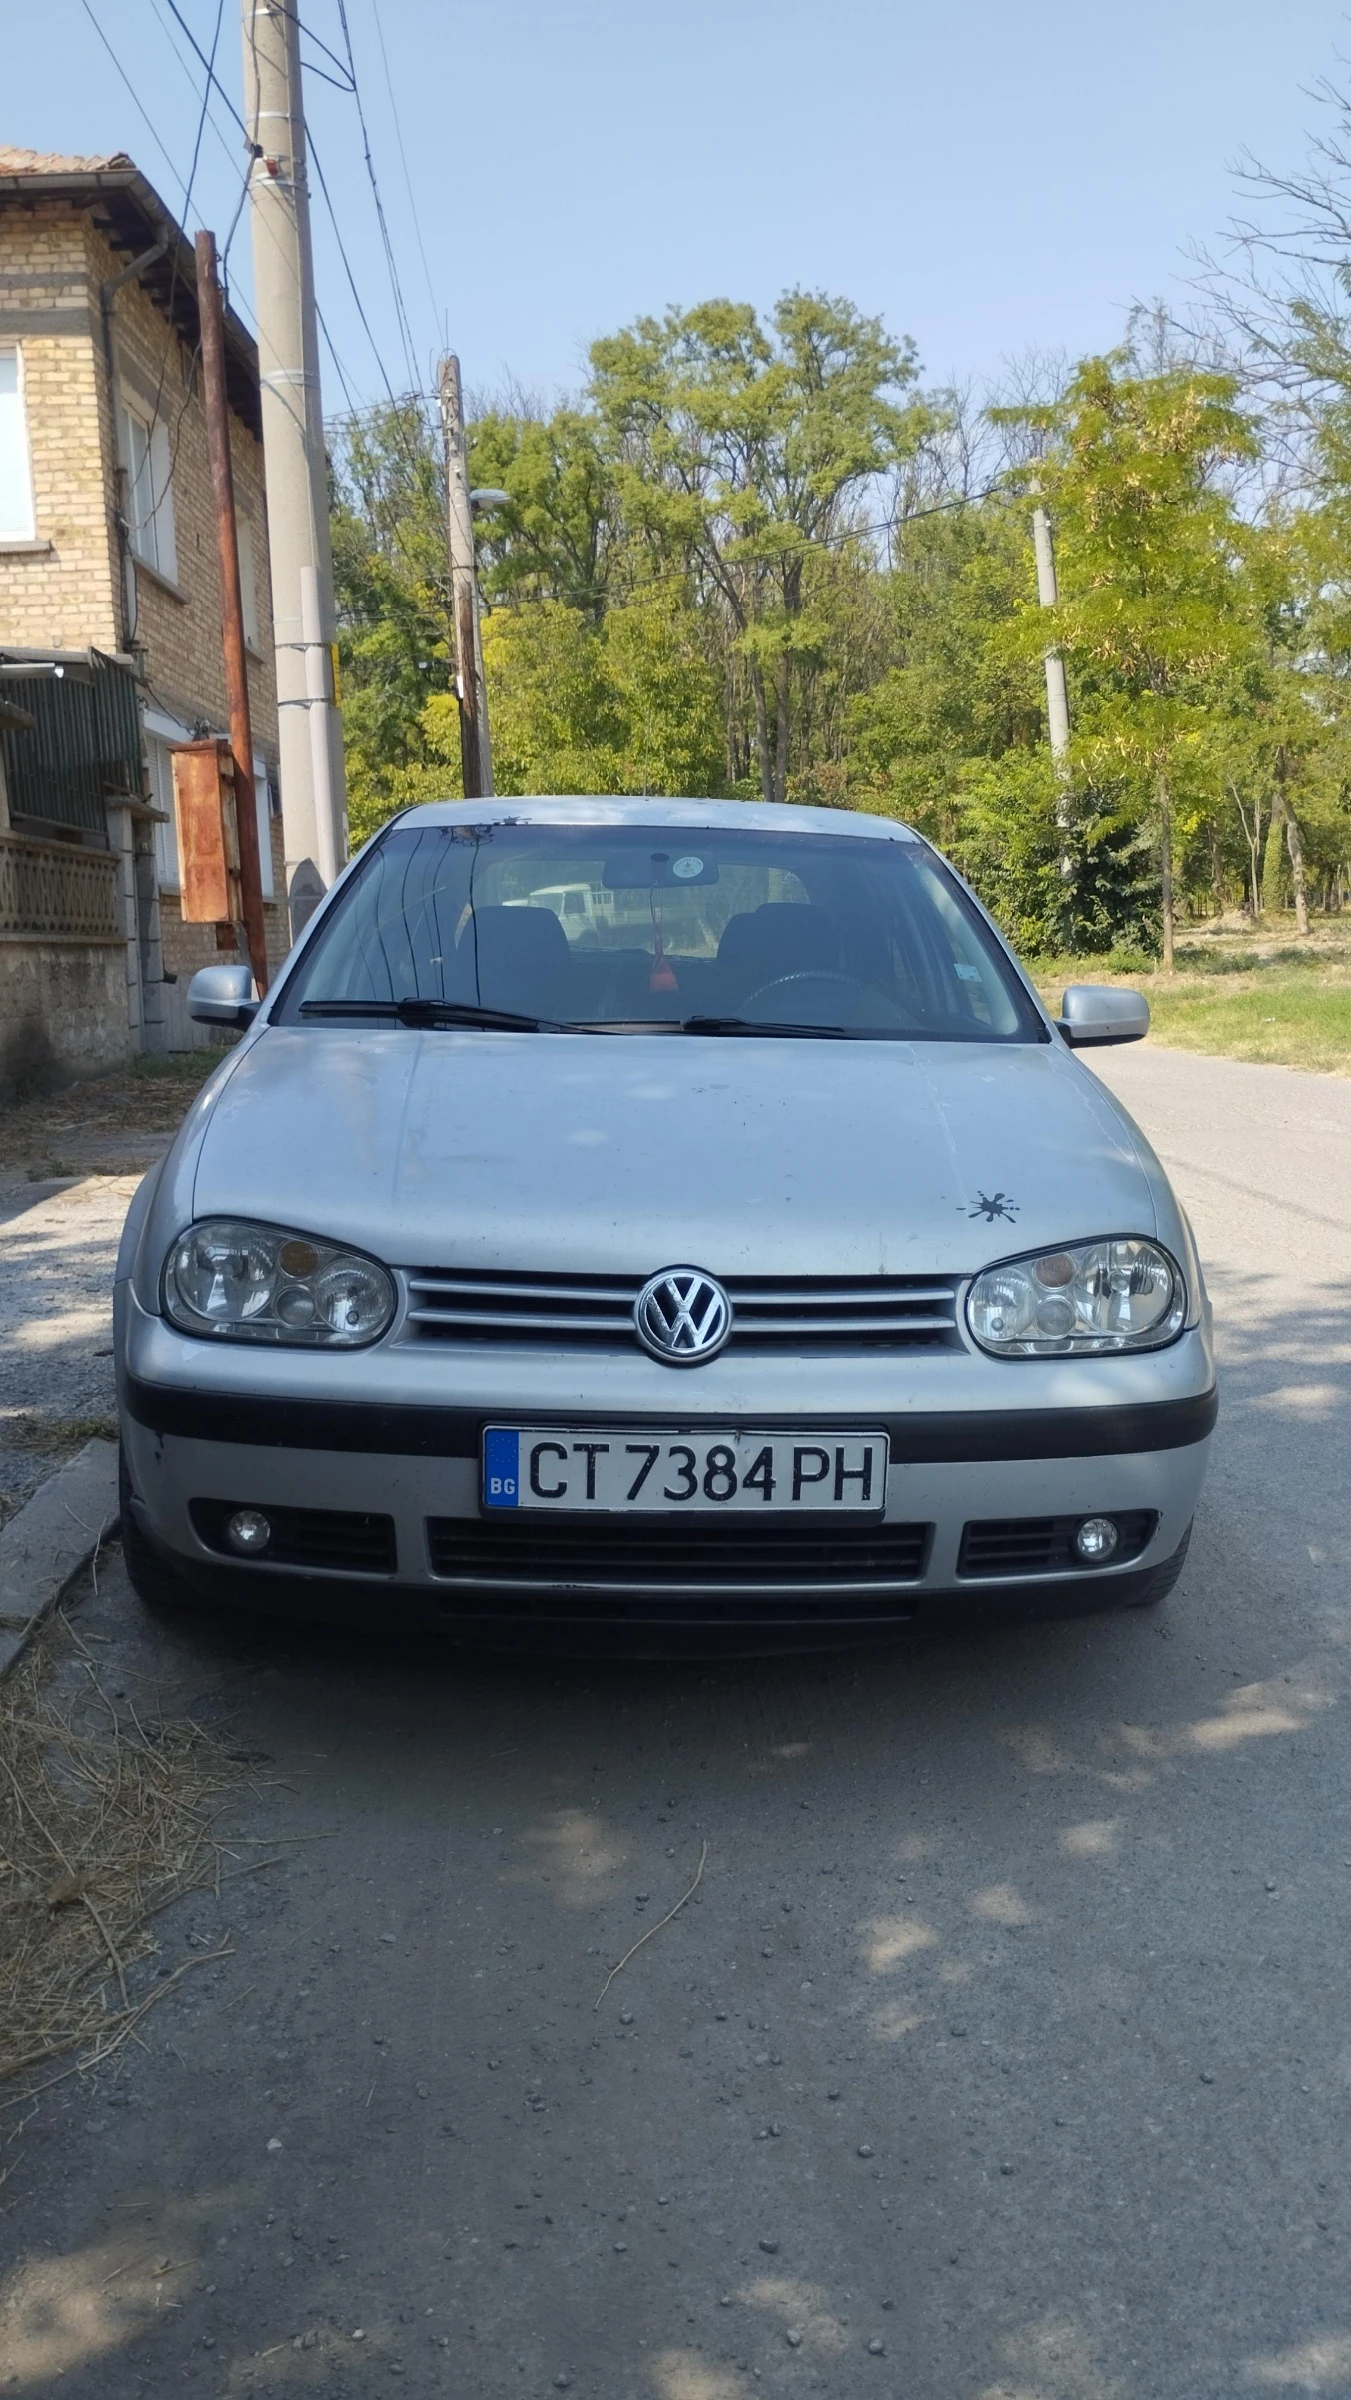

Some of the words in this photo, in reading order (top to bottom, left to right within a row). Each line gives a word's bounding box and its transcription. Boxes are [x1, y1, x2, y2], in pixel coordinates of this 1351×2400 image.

[641, 1272, 725, 1354] VW
[490, 1477, 516, 1495] BG
[529, 1441, 610, 1499] CT
[624, 1444, 777, 1502] 7384
[791, 1446, 874, 1502] PH
